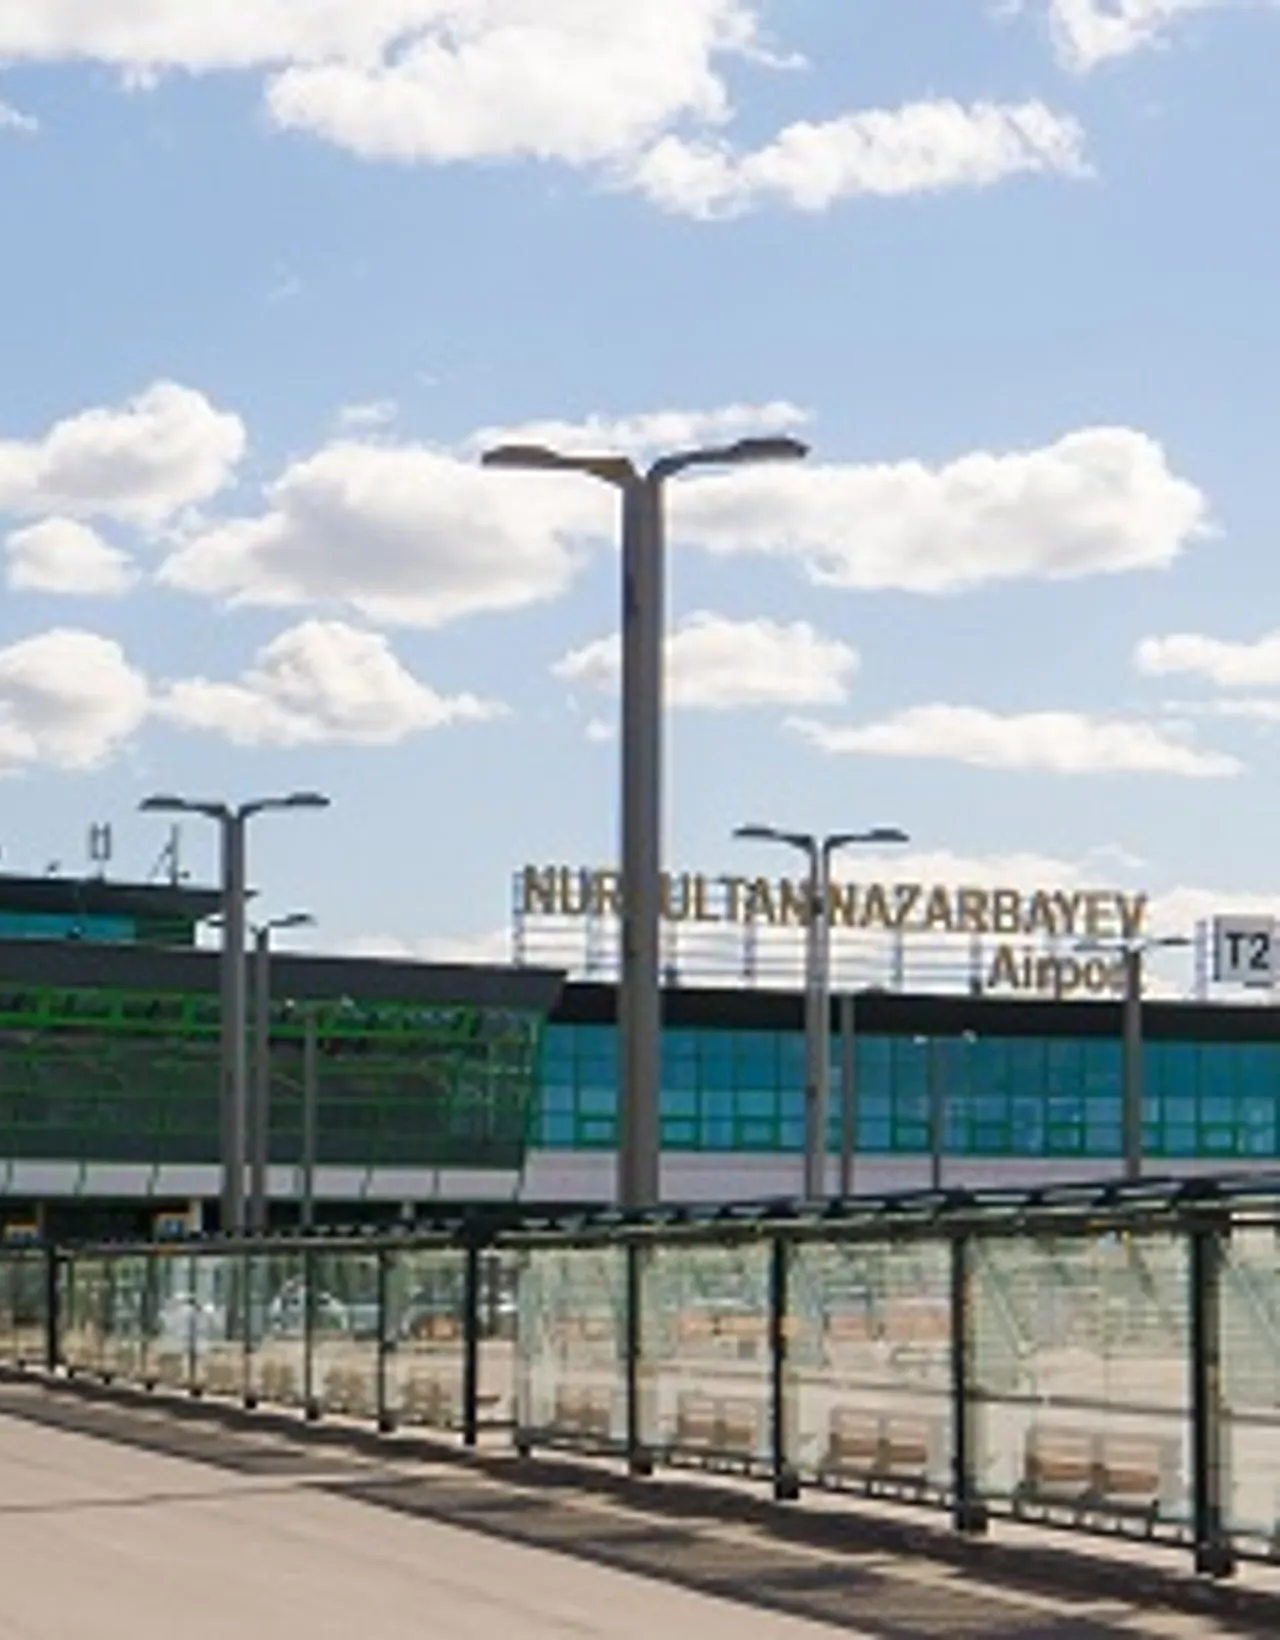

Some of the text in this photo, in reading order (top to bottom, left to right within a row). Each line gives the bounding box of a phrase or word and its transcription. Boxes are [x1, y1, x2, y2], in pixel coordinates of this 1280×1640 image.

[523, 864, 1148, 938] NURULTAN NAZARBAYEV
[987, 943, 1146, 998] Airpor
[1224, 931, 1270, 970] T2
